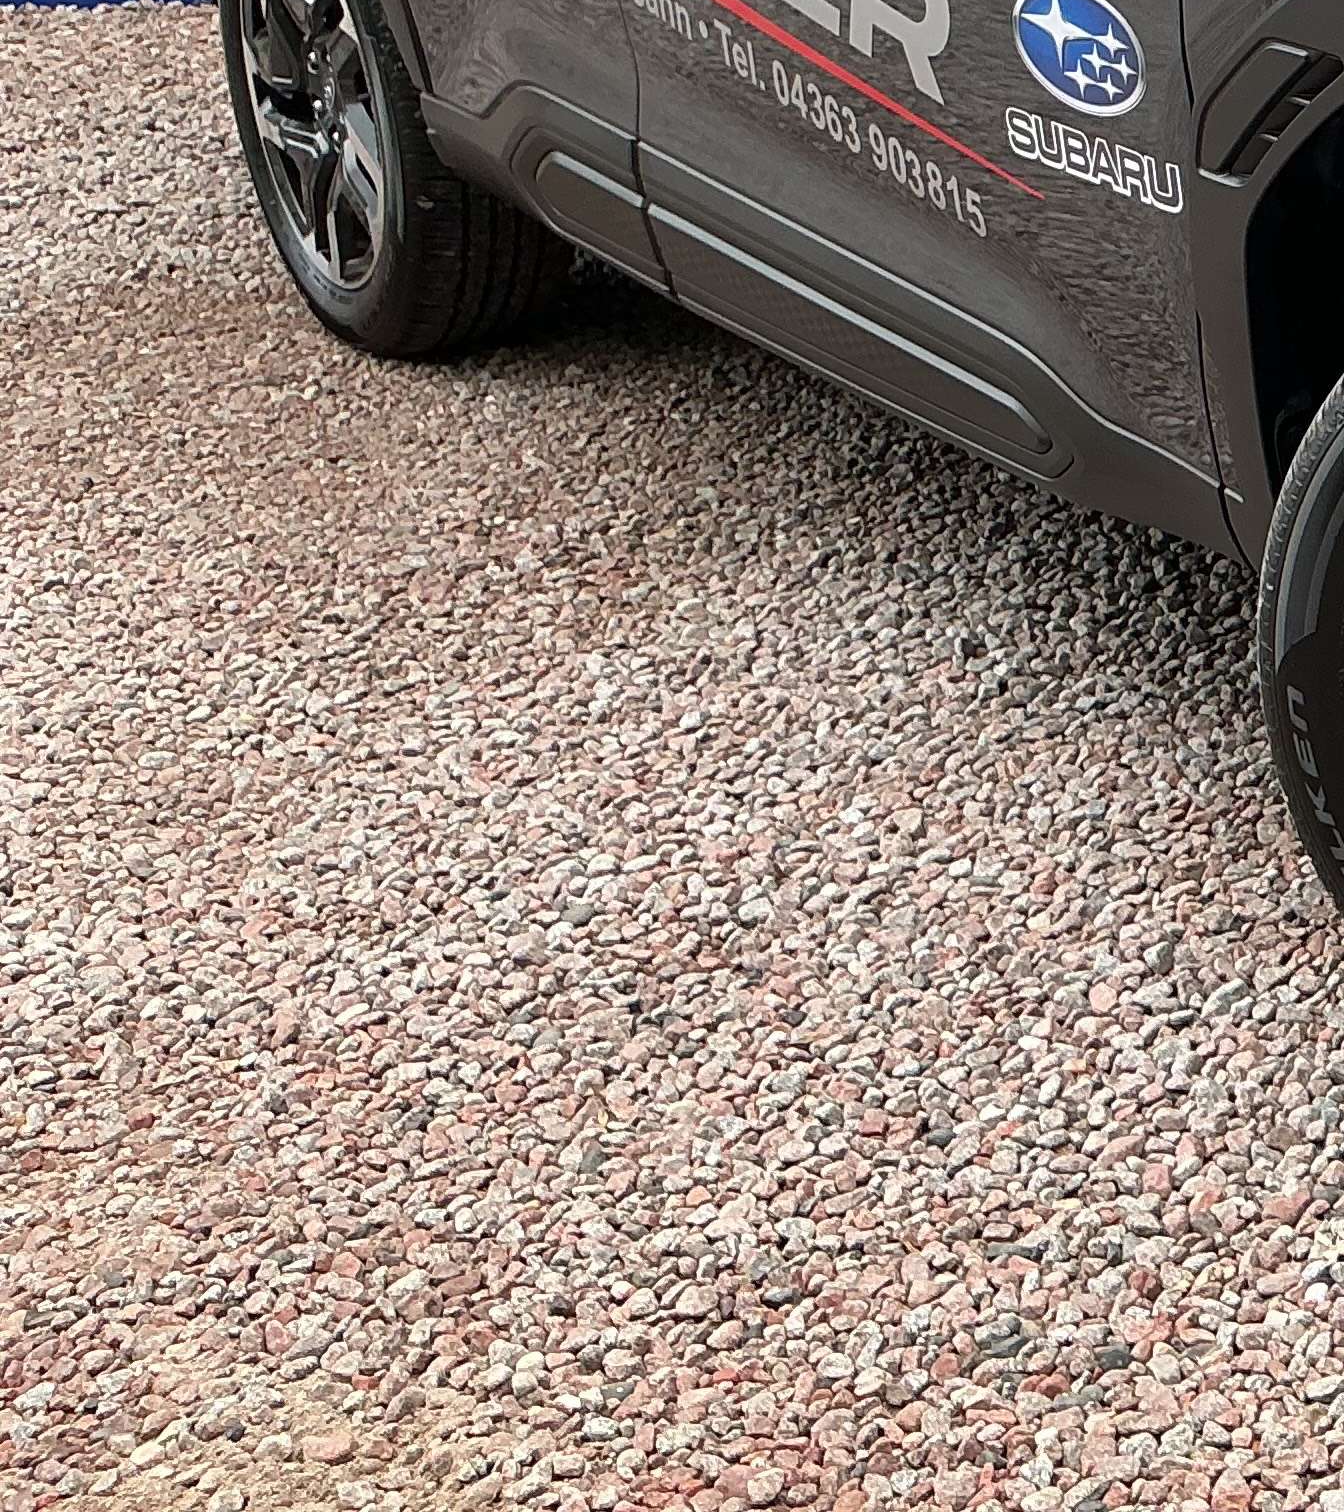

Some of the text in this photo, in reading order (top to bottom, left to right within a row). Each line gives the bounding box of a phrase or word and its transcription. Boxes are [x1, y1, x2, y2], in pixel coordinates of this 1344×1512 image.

[714, 19, 766, 92] Tel.
[772, 59, 862, 154] 04363
[868, 123, 989, 238] 903815
[1004, 106, 1184, 215] SUBARU
